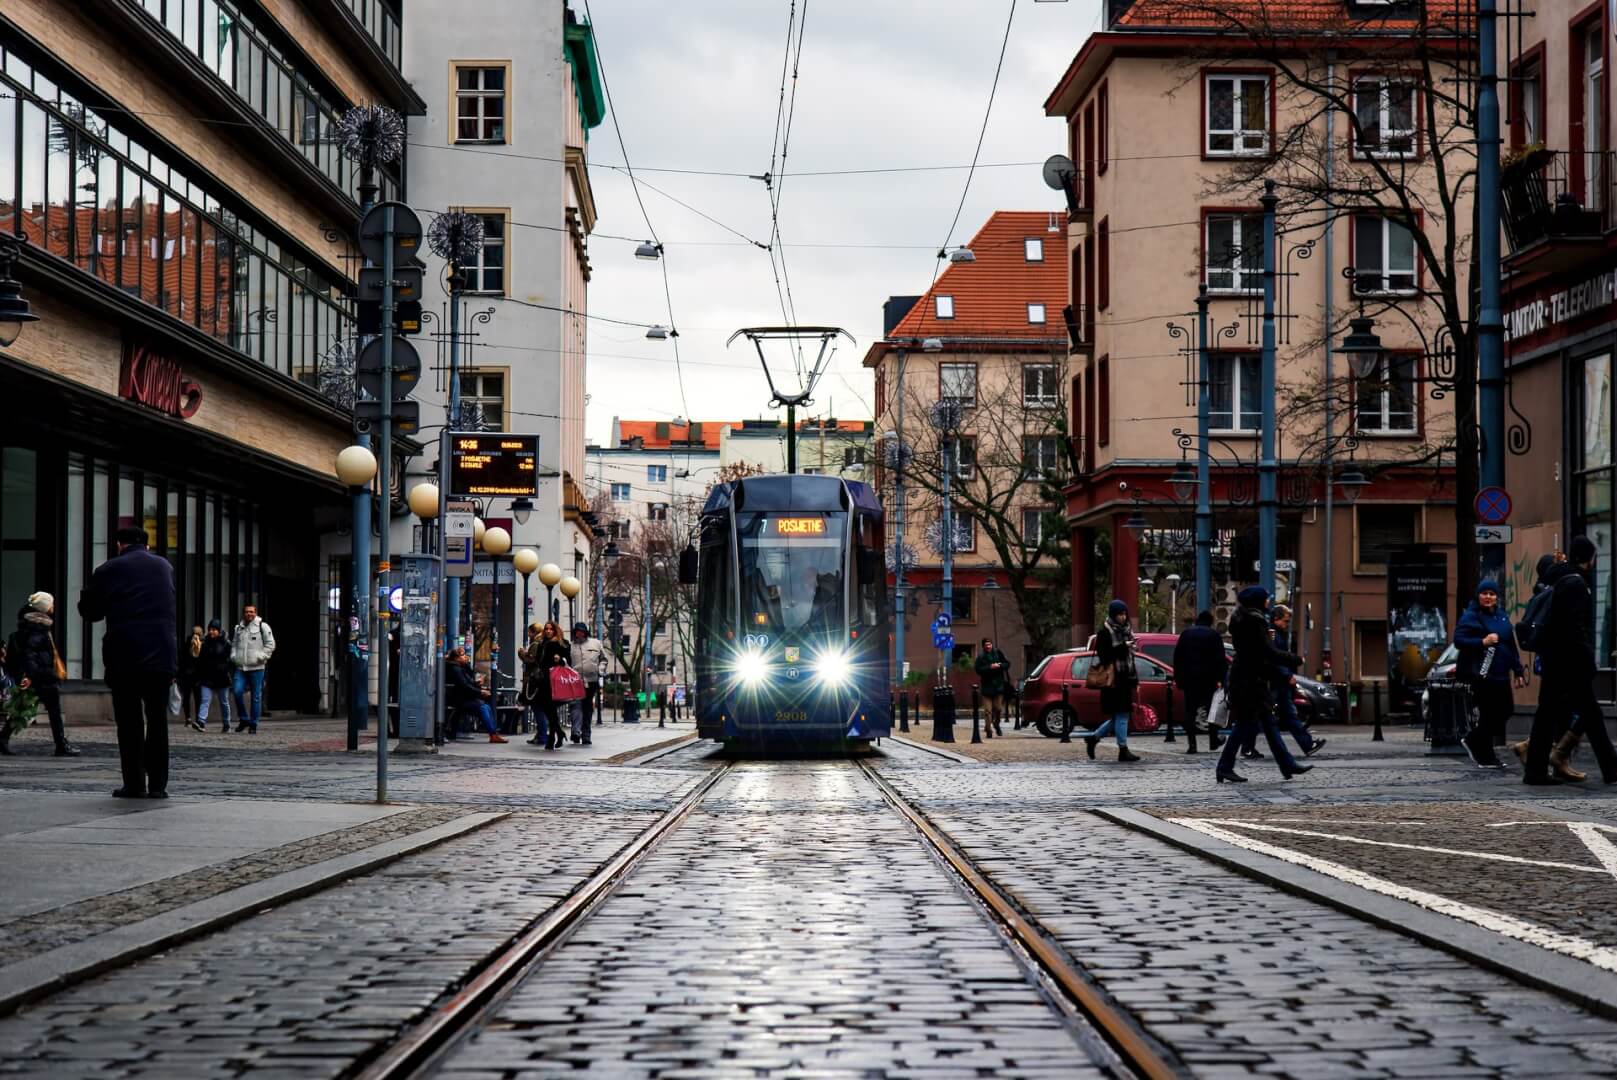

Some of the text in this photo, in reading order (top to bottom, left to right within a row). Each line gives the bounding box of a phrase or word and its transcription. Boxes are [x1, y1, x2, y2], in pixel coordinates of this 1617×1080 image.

[1503, 299, 1544, 343] KANTOR
[1550, 272, 1609, 325] TELEFONY
[762, 519, 768, 533] 7
[473, 567, 514, 577] NOTAIUSZ
[776, 711, 807, 721] 2908
